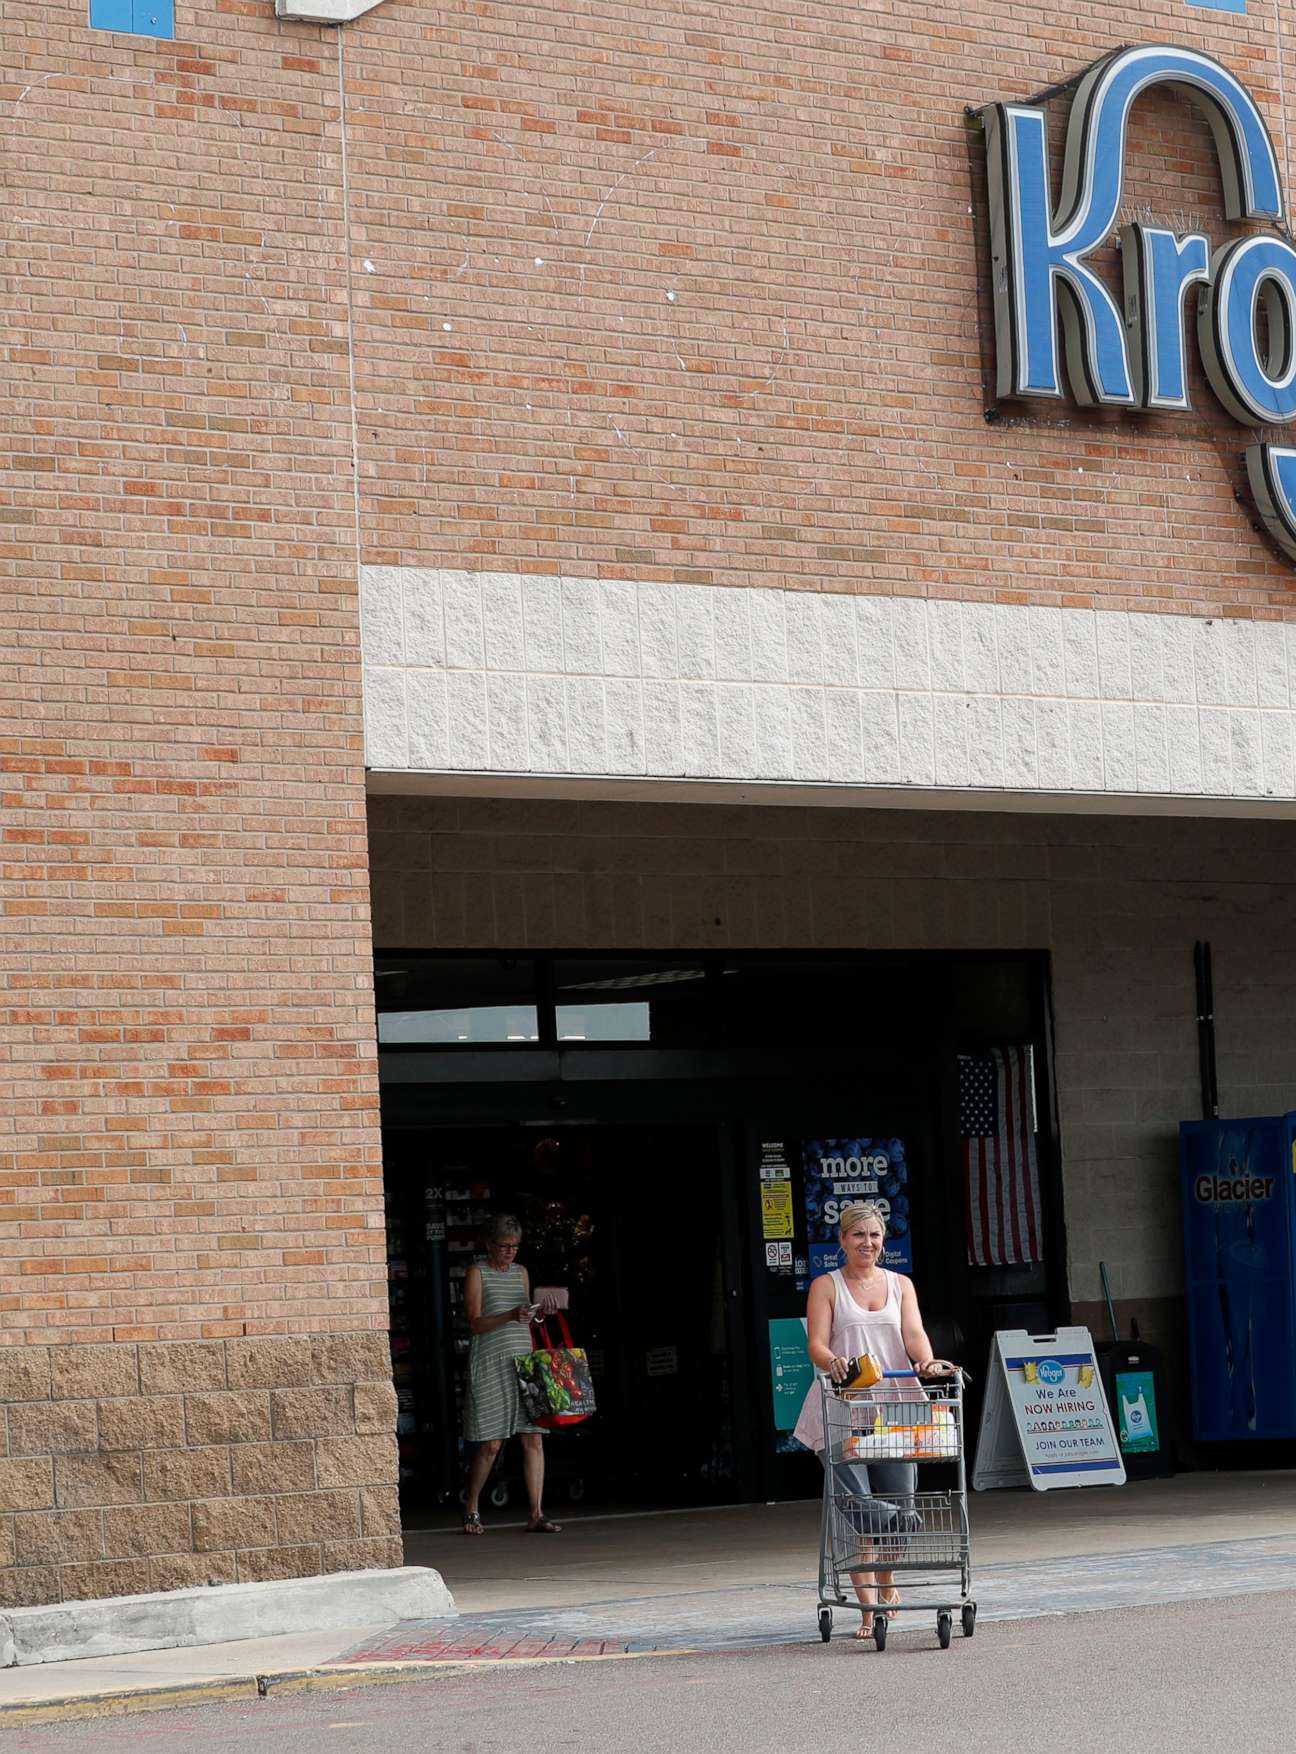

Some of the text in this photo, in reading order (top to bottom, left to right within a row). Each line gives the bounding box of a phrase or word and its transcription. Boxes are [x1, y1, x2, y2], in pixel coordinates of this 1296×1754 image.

[820, 1155, 888, 1178] more
[425, 1187, 443, 1199] 2X
[840, 1182, 873, 1192] WAYS TO
[1195, 1175, 1274, 1201] Glacier
[1040, 1364, 1063, 1382] Kroger
[1036, 1388, 1077, 1399] We Are
[1025, 1401, 1095, 1415] NOW HIRING
[1035, 1438, 1105, 1450] JOIN OUR TEAM
